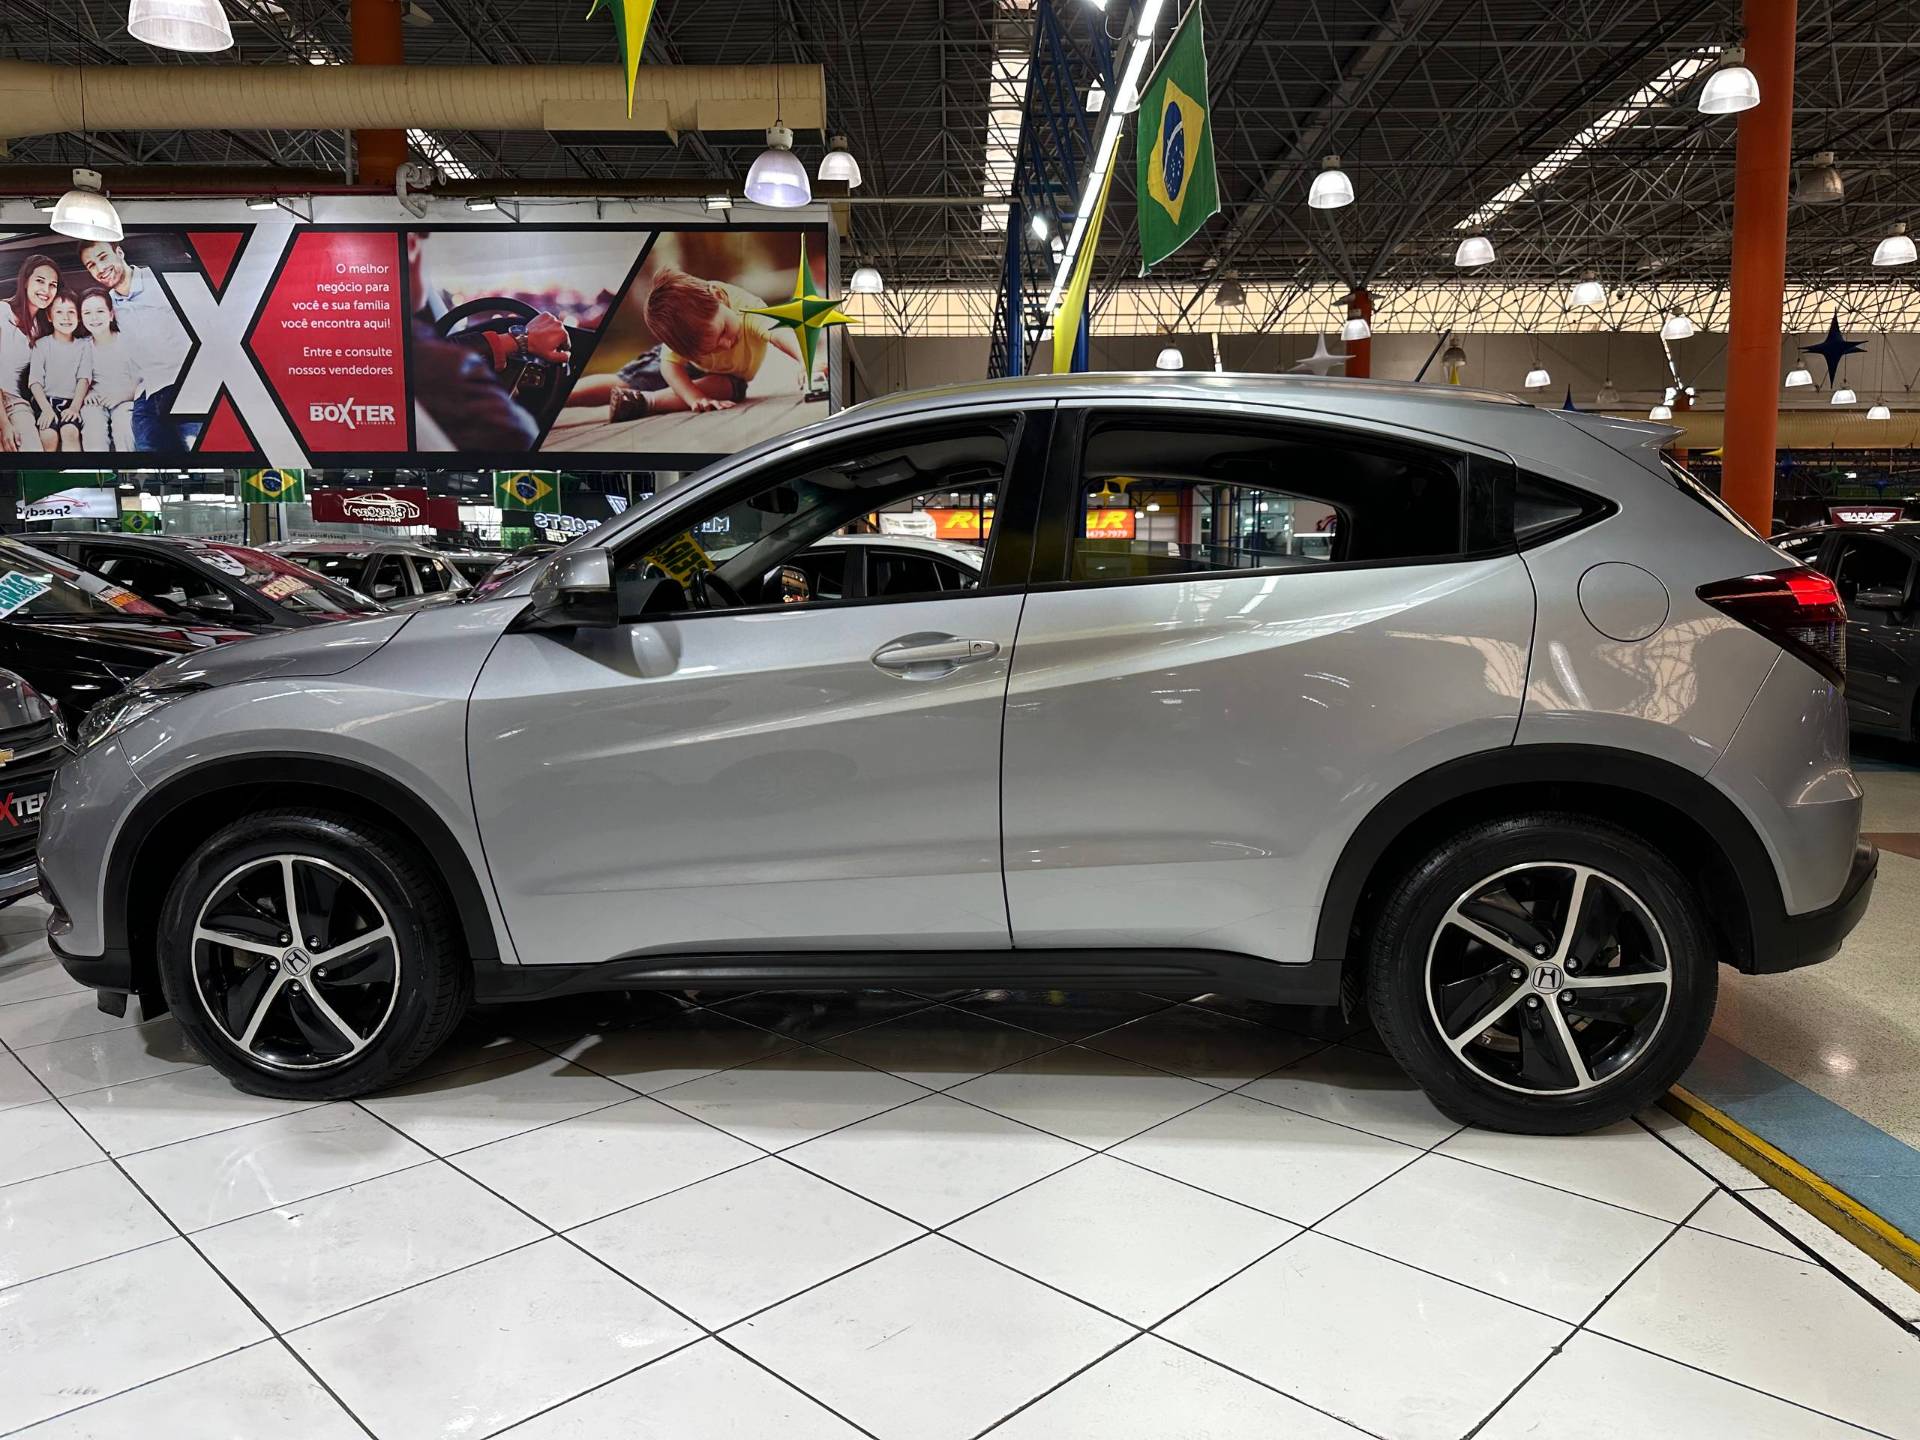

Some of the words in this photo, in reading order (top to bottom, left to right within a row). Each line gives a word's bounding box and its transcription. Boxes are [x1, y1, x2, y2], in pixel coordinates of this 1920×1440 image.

[336, 263, 346, 274] O
[349, 263, 389, 274] melhor
[317, 282, 362, 294] negócio
[365, 284, 390, 294] para
[292, 300, 319, 310] você
[322, 302, 329, 310] e
[332, 302, 351, 310] sua
[353, 300, 390, 310] família
[281, 318, 308, 328] você
[311, 319, 361, 328] encontra
[363, 318, 391, 331] aqui!
[303, 347, 333, 357] Entre
[335, 349, 342, 357] e
[345, 347, 392, 357] consulte
[288, 367, 326, 375] nossos
[329, 365, 394, 375] vendedores
[309, 397, 395, 429] BOXTER
